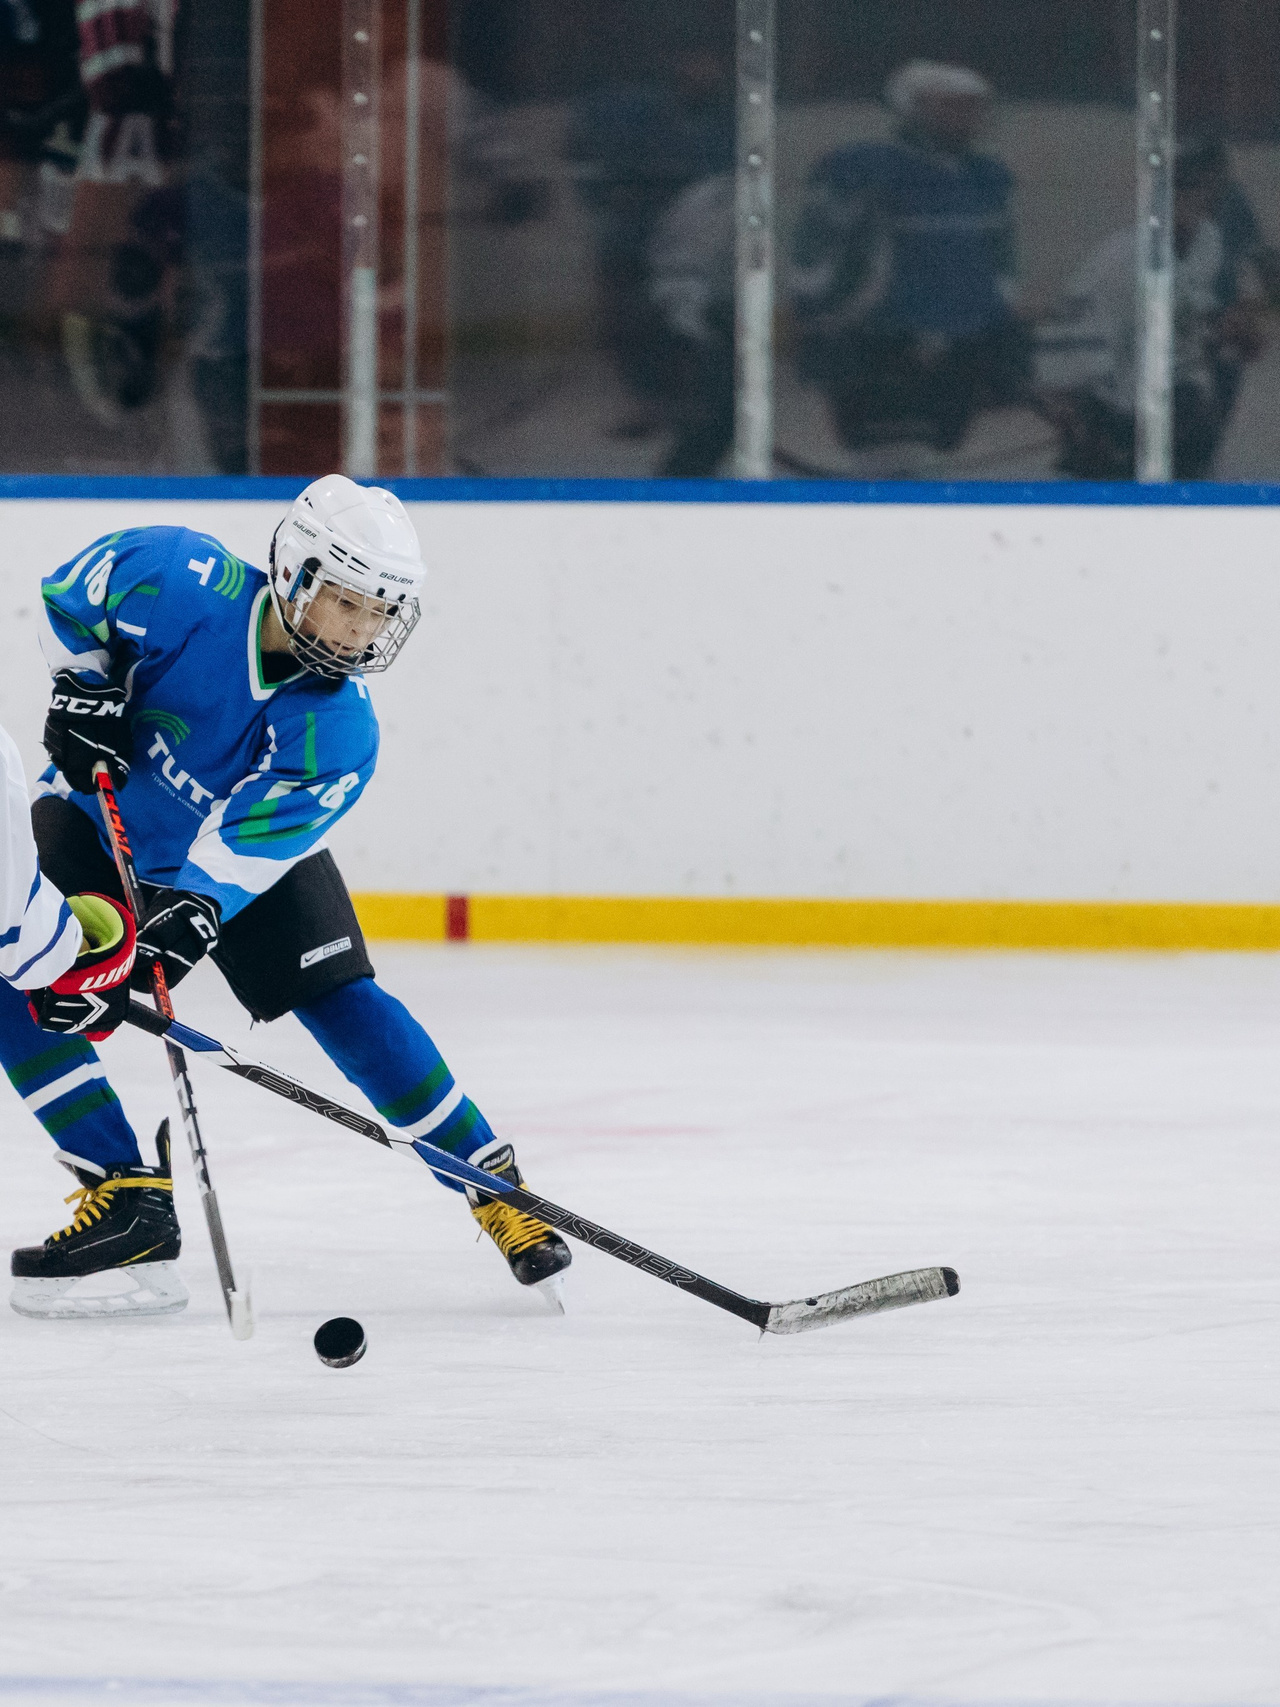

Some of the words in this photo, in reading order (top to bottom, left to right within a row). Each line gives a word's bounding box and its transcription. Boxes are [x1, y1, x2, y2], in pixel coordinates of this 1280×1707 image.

[292, 520, 317, 539] BAUER
[379, 571, 414, 586] BAUER
[50, 693, 125, 718] CCM
[525, 1200, 698, 1288] FISCHER
